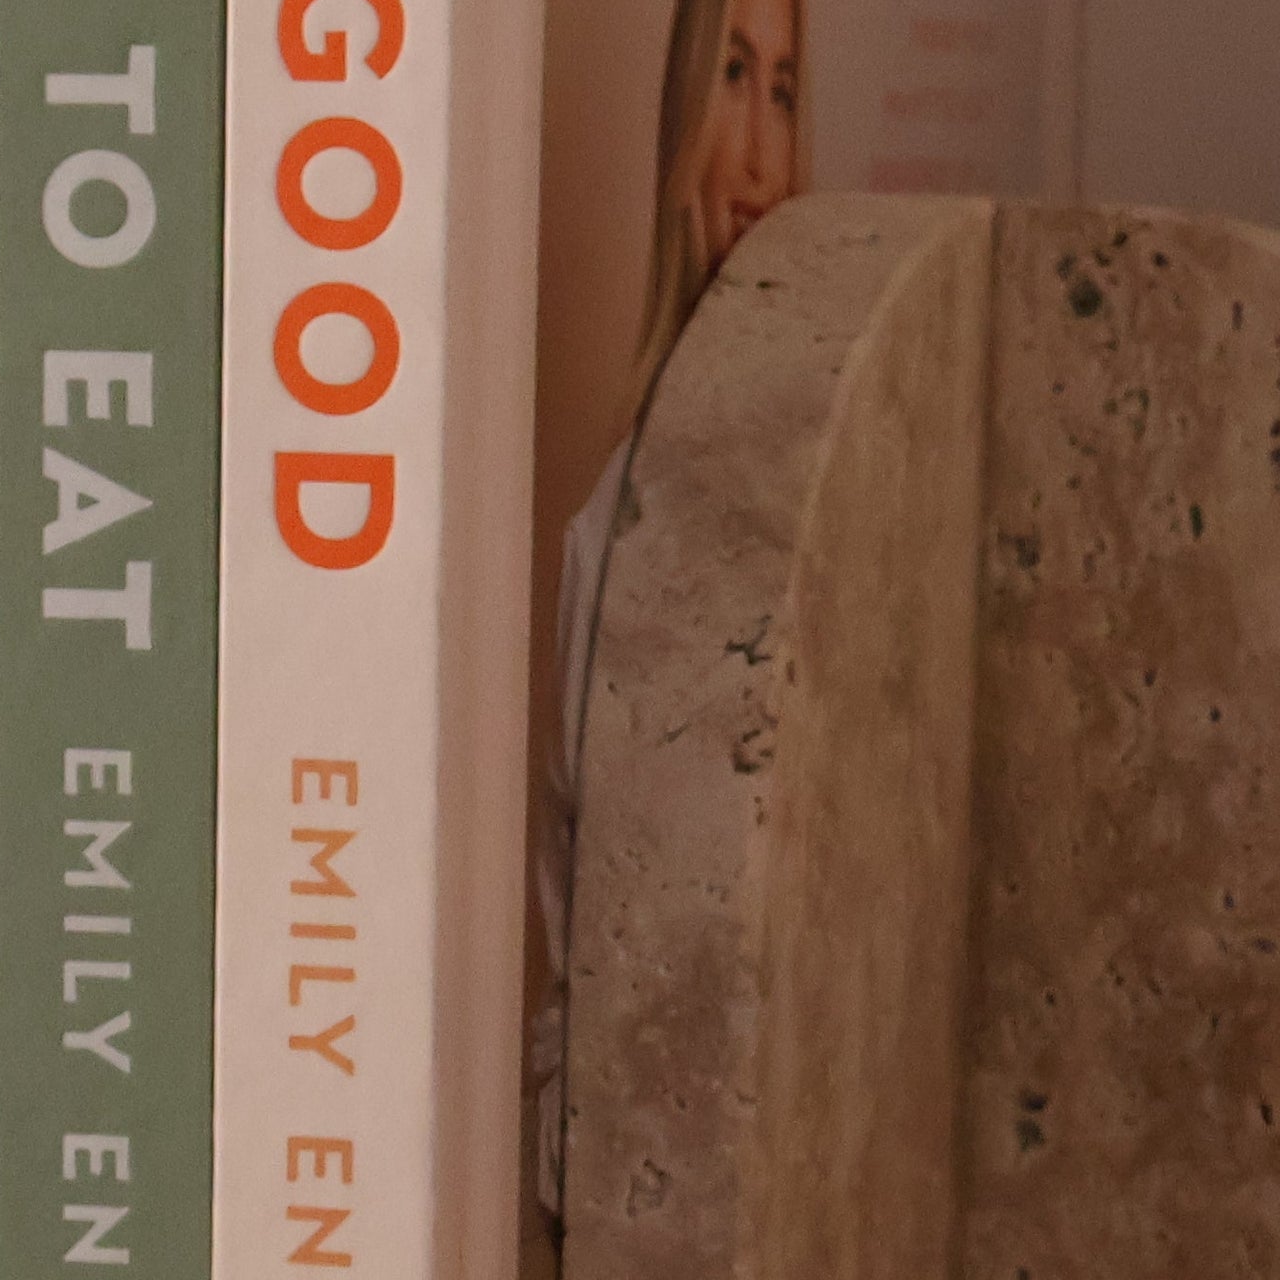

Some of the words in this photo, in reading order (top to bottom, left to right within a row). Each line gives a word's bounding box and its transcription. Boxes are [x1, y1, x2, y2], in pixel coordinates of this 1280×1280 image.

[42, 45, 157, 268] TO
[42, 350, 154, 650] EAT
[63, 748, 133, 1074] EMILY
[288, 758, 359, 1077] EMILY
